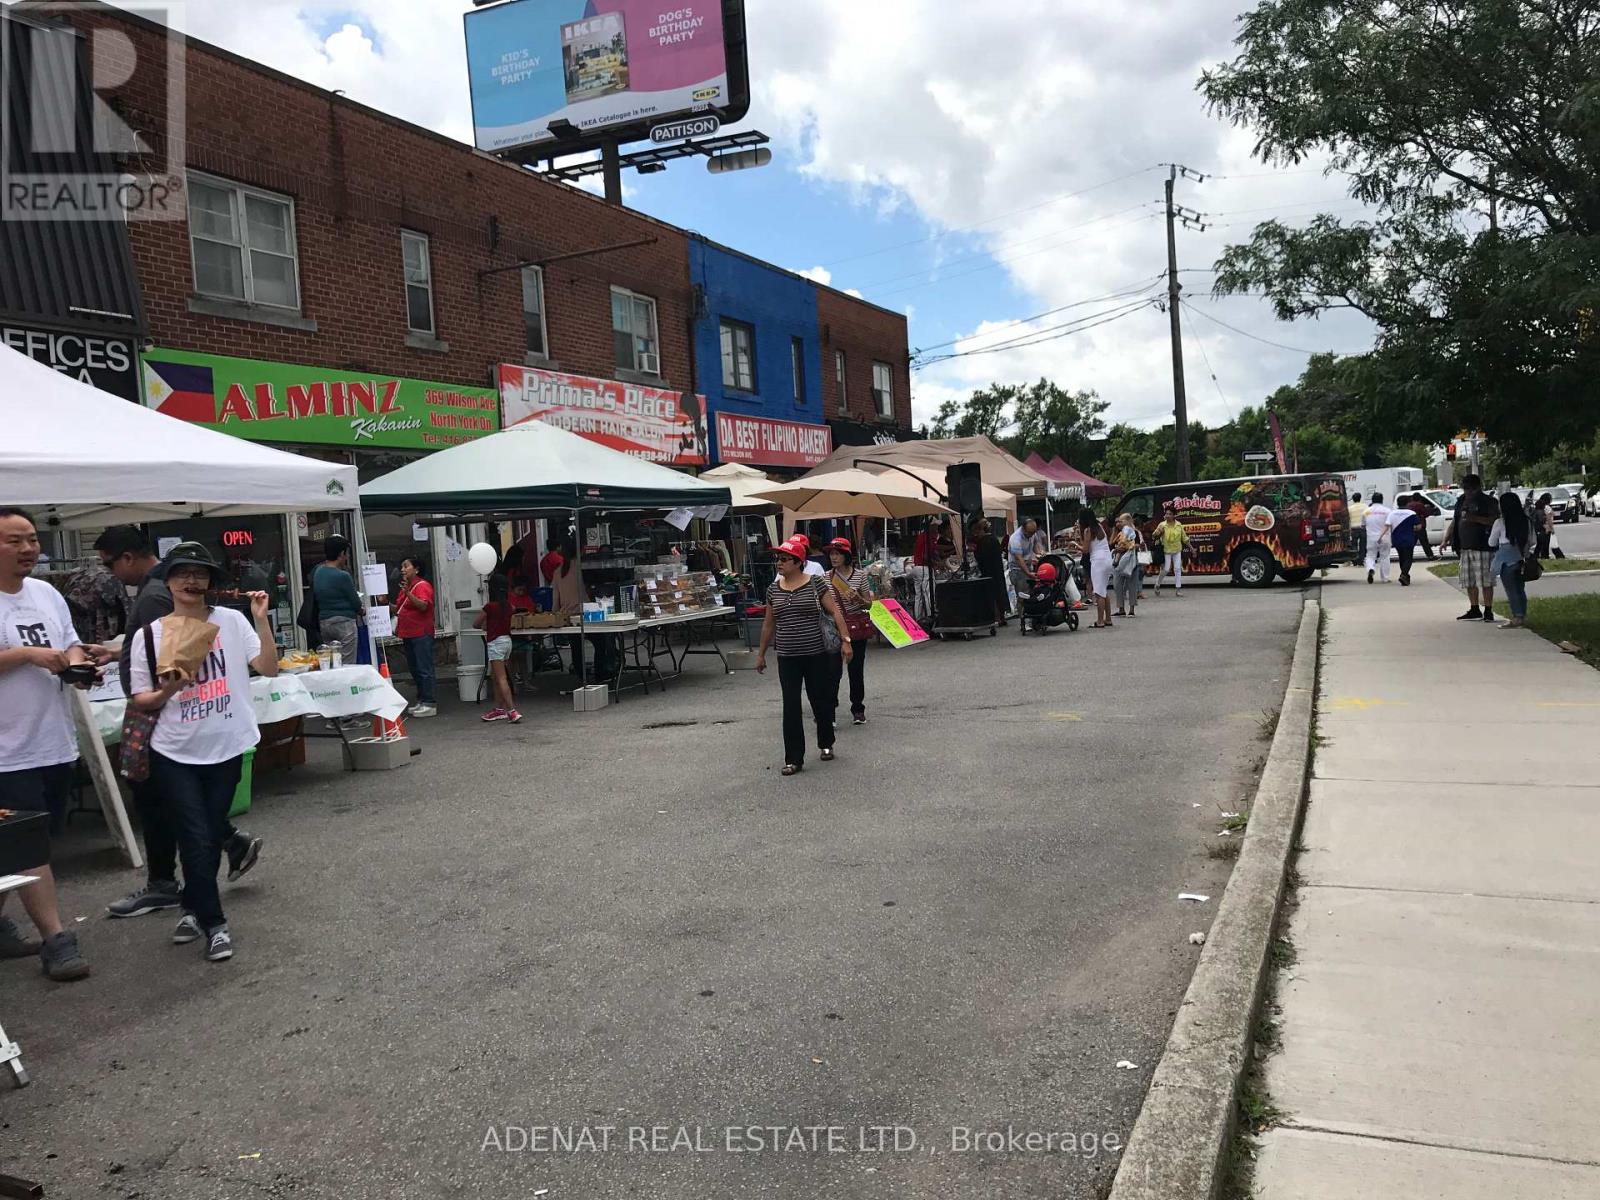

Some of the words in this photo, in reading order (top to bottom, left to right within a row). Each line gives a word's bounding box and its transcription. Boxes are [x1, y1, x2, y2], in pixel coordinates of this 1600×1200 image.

[648, 16, 704, 37] BIRTHDAY
[658, 8, 692, 24] DOG'S
[564, 15, 620, 40] IKEA
[659, 30, 694, 46] PARTY
[502, 48, 529, 63] KID'S
[491, 56, 541, 77] BIRTHDAY
[501, 69, 533, 85] PARTY
[581, 119, 597, 128] IKEA
[598, 110, 632, 122] Catalogue
[655, 120, 714, 141] PATTISON
[0, 328, 130, 372] FFICES
[217, 379, 404, 424] ALMINZ
[425, 389, 444, 406] 369
[447, 391, 478, 409] Wilson
[521, 371, 616, 411] Prima's
[623, 387, 676, 418] Place
[351, 415, 423, 441] Kakanin
[430, 410, 457, 429] North
[458, 414, 478, 430] York
[600, 419, 628, 436] HAIR
[720, 417, 734, 447] DA
[736, 420, 760, 450] BEST
[761, 424, 798, 453] FILIPINO
[799, 427, 829, 455] BAKERY
[223, 530, 253, 546] OPEN
[194, 648, 226, 685] UN
[200, 678, 231, 701] GIRL
[180, 700, 192, 708] TRY
[181, 700, 214, 723] KEEP
[216, 694, 231, 713] UP
